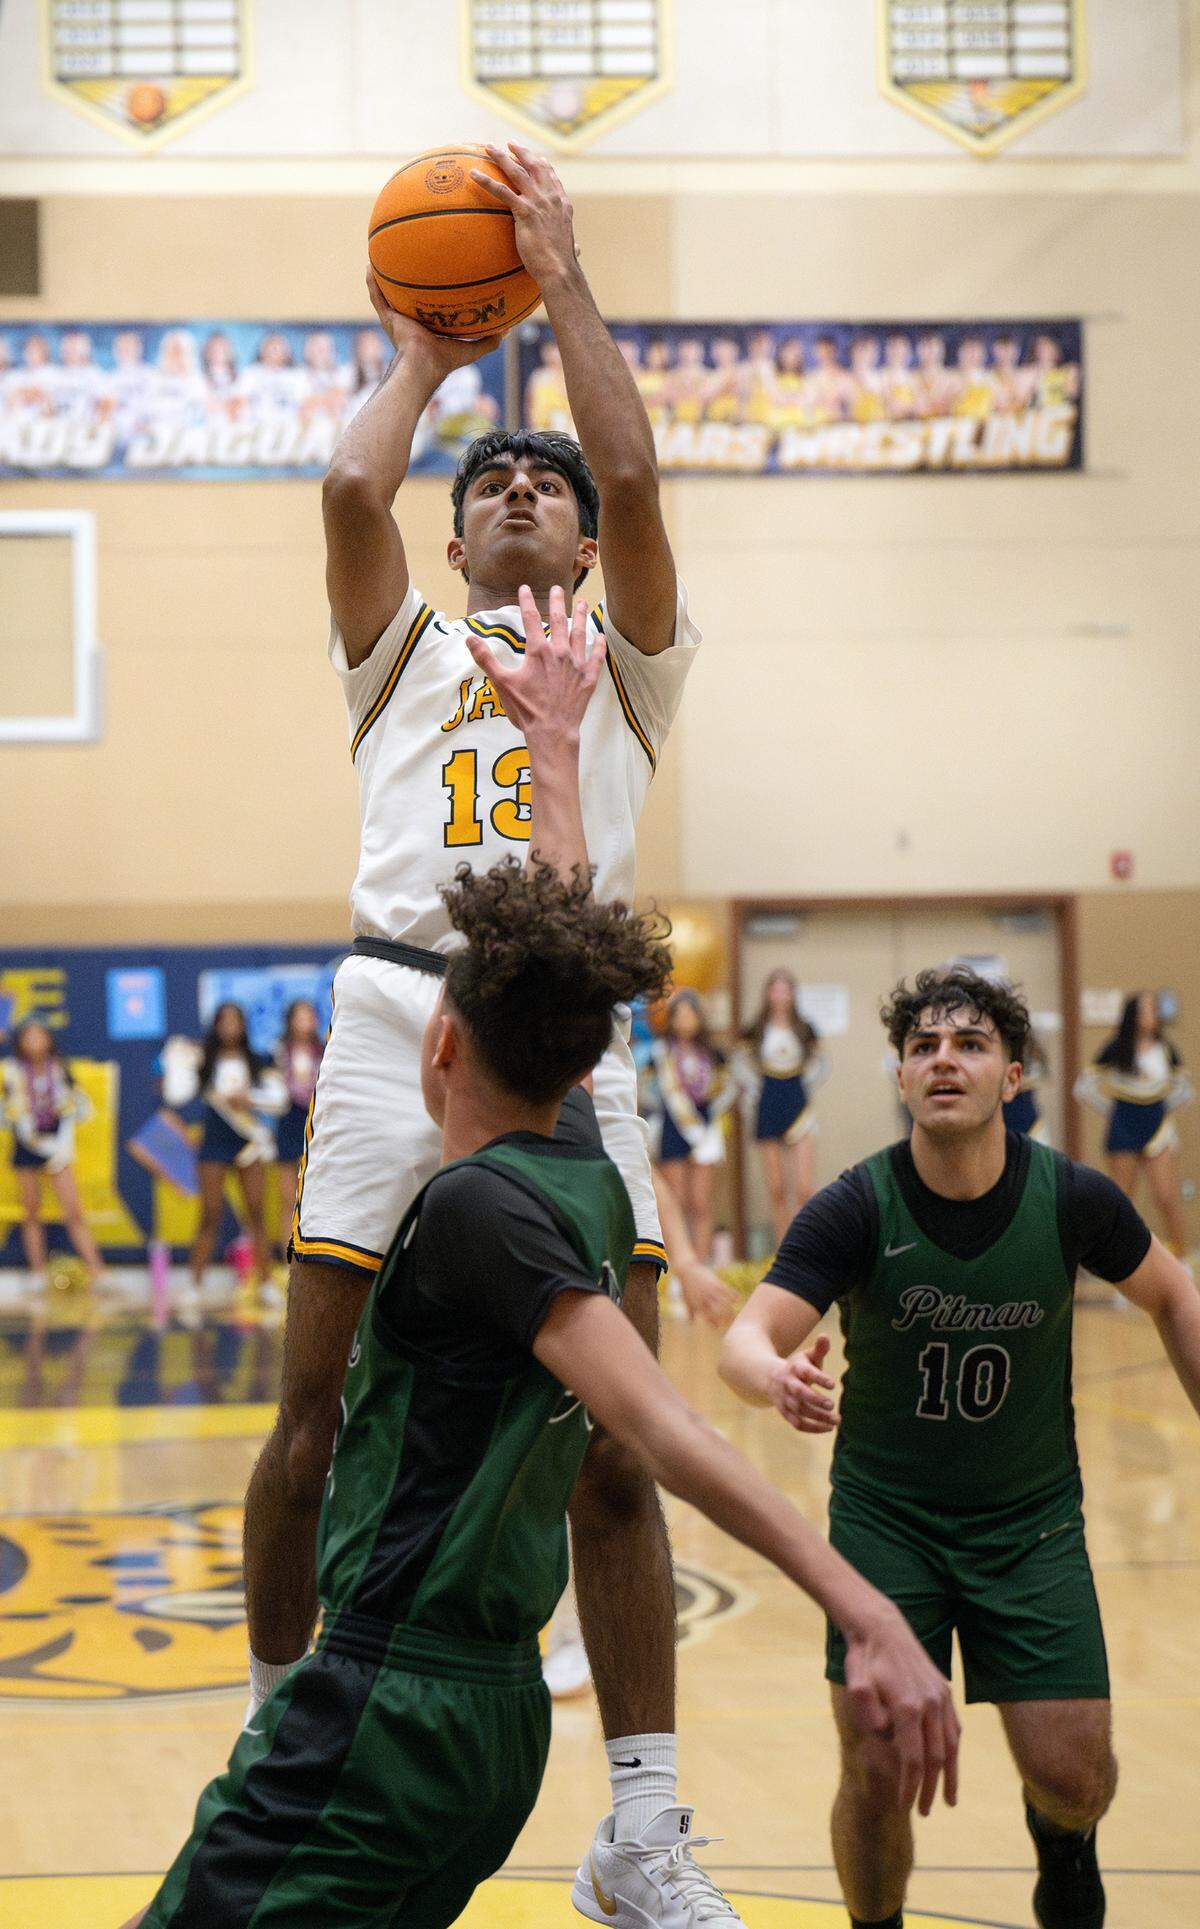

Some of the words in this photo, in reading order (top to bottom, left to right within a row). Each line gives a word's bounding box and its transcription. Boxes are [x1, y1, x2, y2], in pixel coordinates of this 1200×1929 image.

[125, 415, 346, 467] JAGUA
[778, 405, 1074, 467] WRESTLING
[441, 676, 507, 732] JA
[442, 746, 532, 848] 13
[891, 1285, 1044, 1331] Pitman
[916, 1342, 1010, 1422] 10
